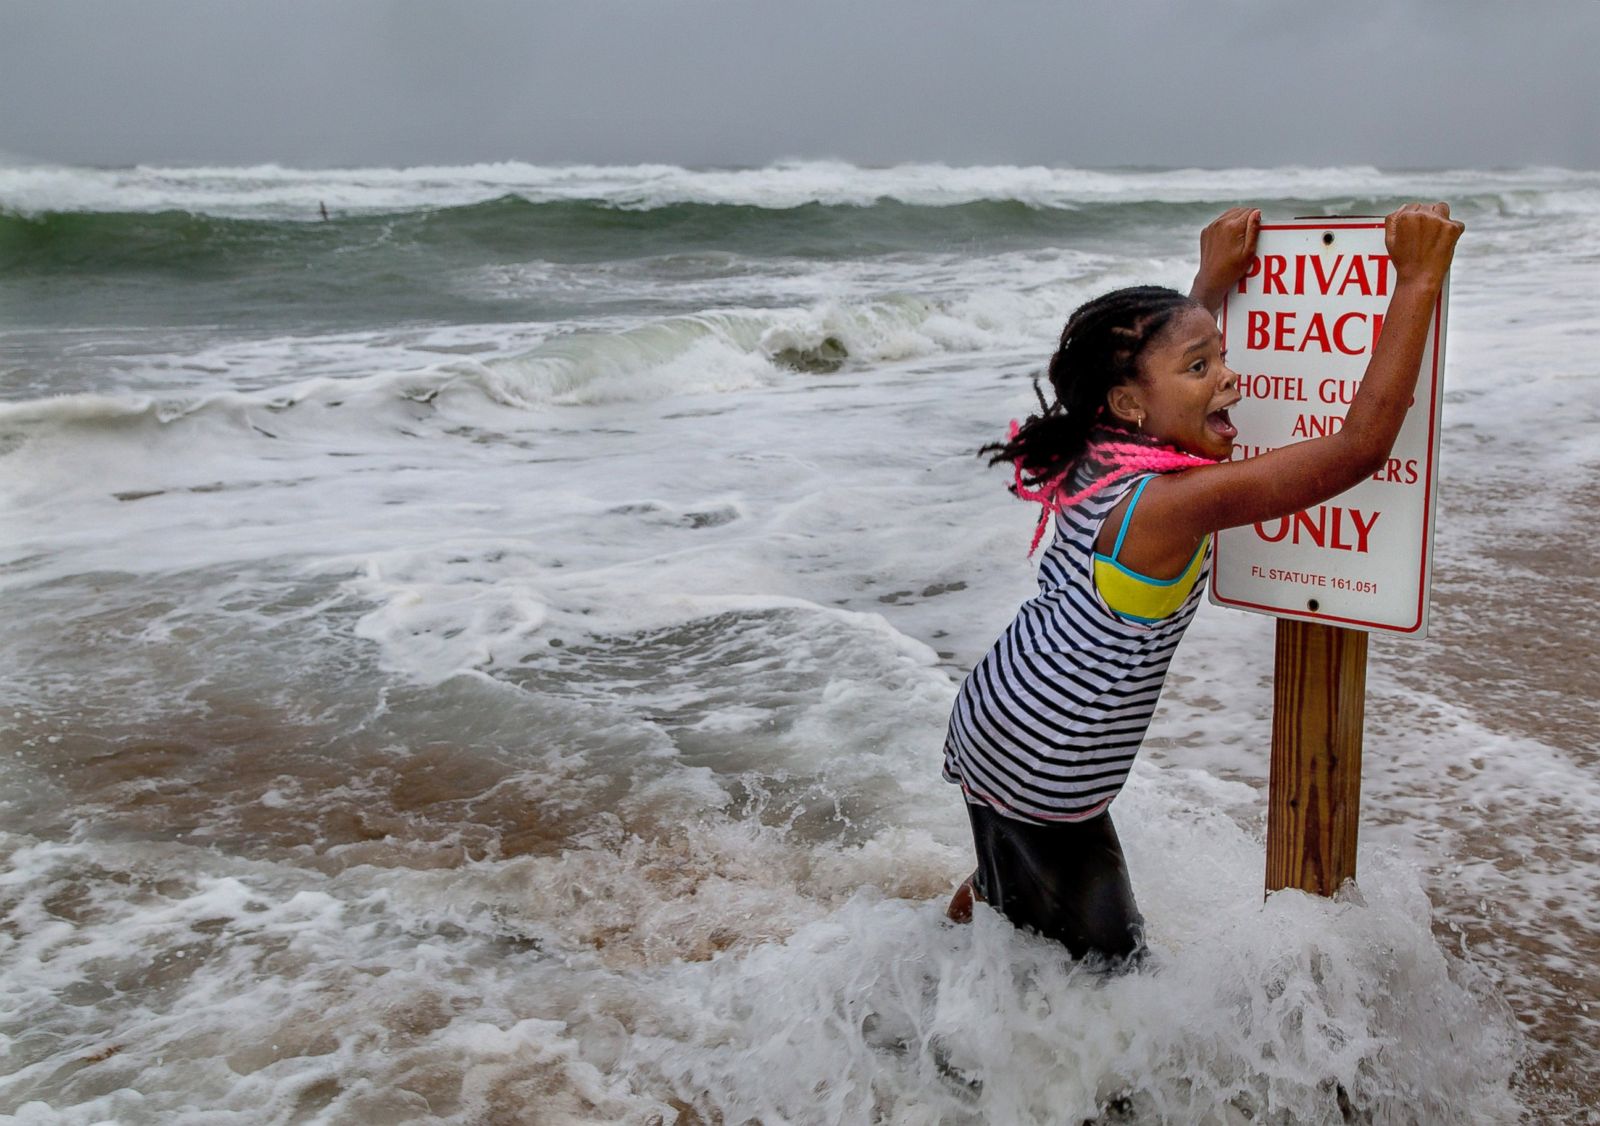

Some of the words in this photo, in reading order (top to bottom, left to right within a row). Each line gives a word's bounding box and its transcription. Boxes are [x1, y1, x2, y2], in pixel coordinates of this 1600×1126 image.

[1237, 254, 1394, 296] PRIVAT
[1246, 310, 1386, 355] BEAC
[1236, 374, 1308, 402] HOTEL
[1291, 413, 1345, 437] AND
[1251, 565, 1266, 579] FL
[1269, 568, 1327, 587] STATUTE
[1330, 577, 1378, 594] 161.051
